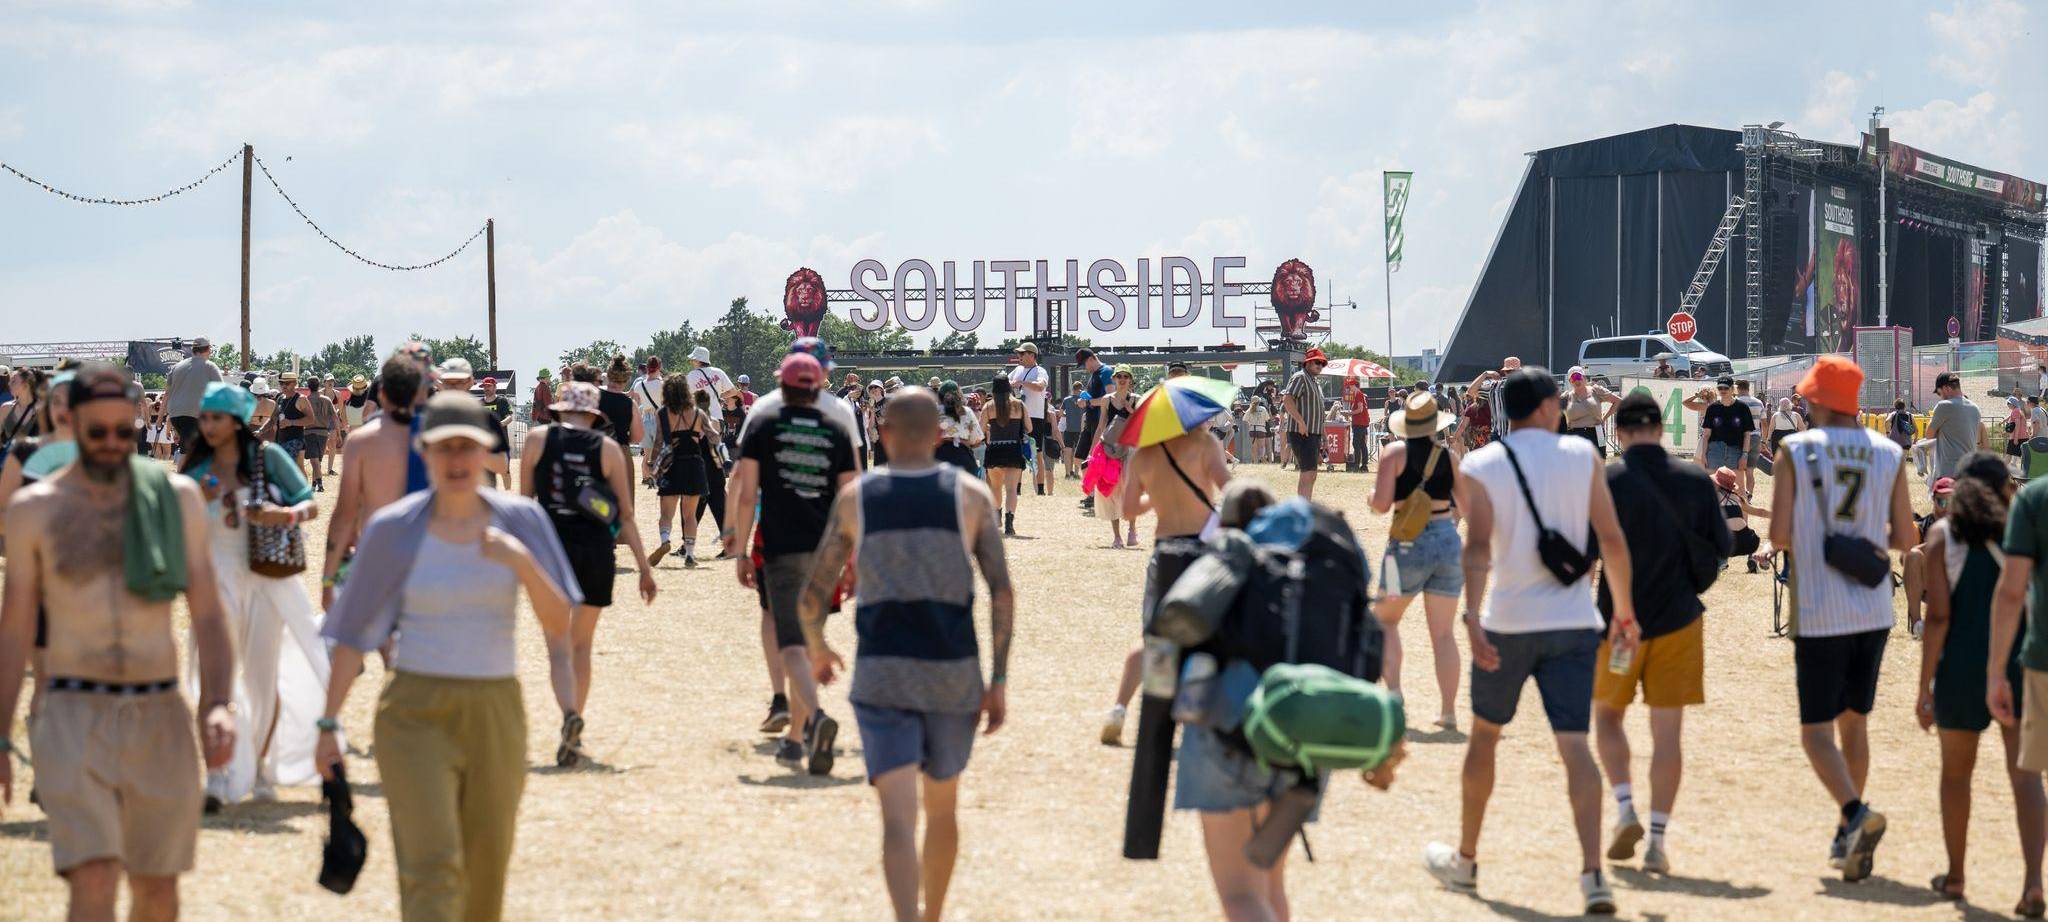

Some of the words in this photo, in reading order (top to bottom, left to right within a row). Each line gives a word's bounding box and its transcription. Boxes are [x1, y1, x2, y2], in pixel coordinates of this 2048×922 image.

[1945, 166, 1974, 188] SOUTHSIDE
[1825, 202, 1854, 226] SOUTHSIDE
[849, 256, 1247, 332] SOUTHSIDE
[1670, 321, 1693, 334] STOP
[1326, 433, 1339, 447] CE
[1834, 464, 1866, 522] 7
